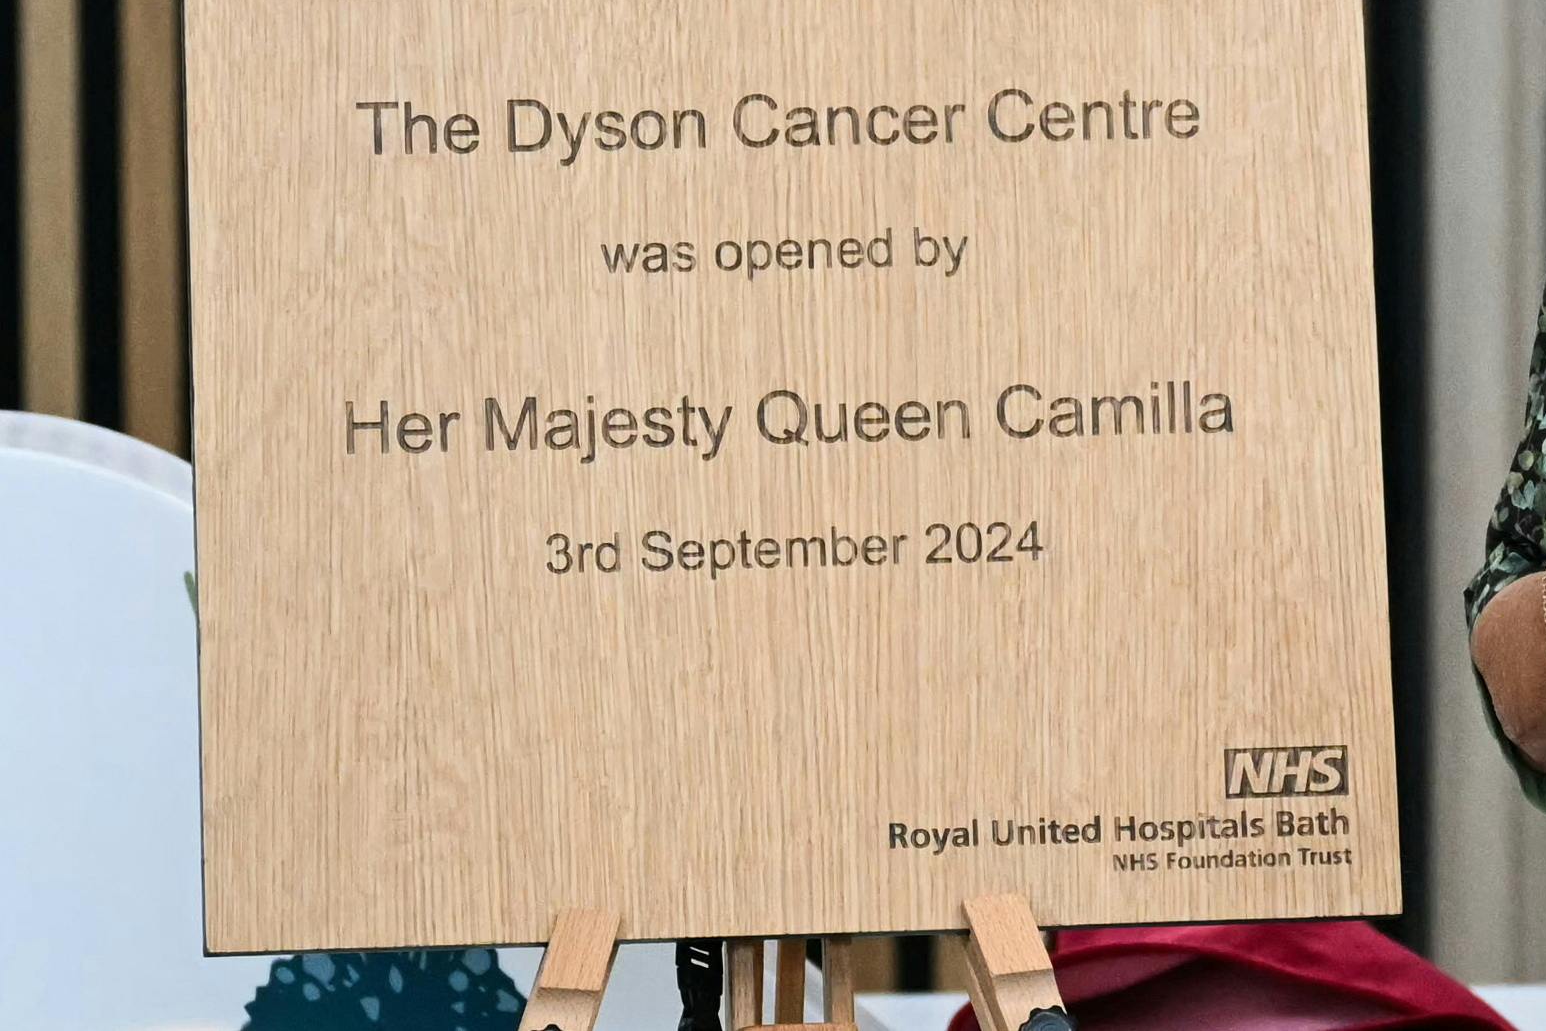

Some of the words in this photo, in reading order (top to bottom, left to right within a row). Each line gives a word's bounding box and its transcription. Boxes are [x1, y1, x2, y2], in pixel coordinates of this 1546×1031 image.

[357, 100, 479, 155] The
[506, 98, 707, 166] Dyson
[733, 94, 966, 148] Cancer
[987, 88, 1200, 143] Centre
[601, 239, 696, 274] was
[715, 229, 893, 280] opened
[913, 226, 968, 276] by
[346, 400, 461, 455] Her
[484, 395, 733, 464] Majesty
[756, 389, 971, 446] Queen
[995, 382, 1235, 439] Camilla
[546, 532, 622, 574] 3rd
[641, 527, 906, 580] September
[925, 521, 1044, 564] 2024
[1229, 749, 1343, 794] NHS
[889, 819, 979, 854] Royal
[992, 816, 1101, 845] United
[1114, 810, 1265, 848] Hospitals
[1277, 808, 1349, 836] Bath
[1114, 854, 1159, 871] NHS
[1167, 849, 1291, 870] Foundation
[1299, 847, 1352, 865] Trust
